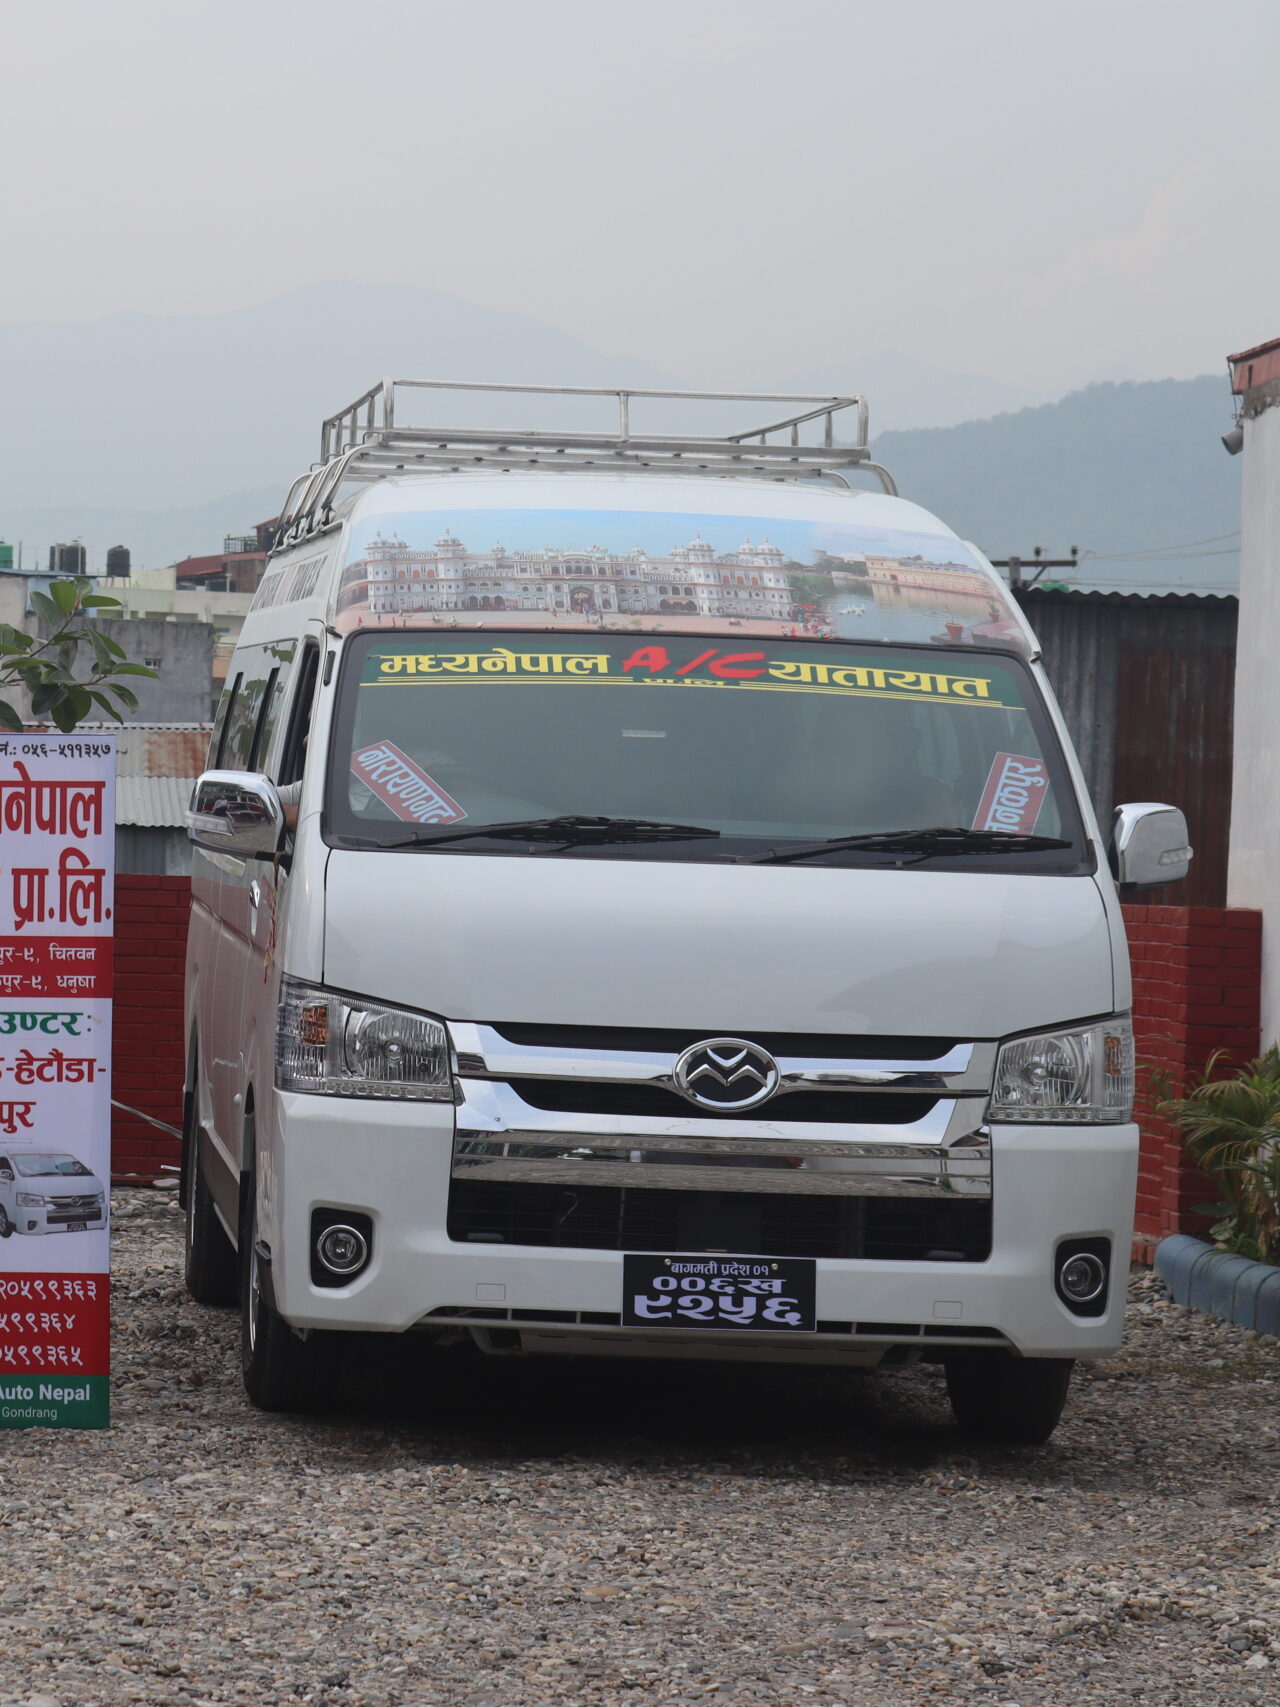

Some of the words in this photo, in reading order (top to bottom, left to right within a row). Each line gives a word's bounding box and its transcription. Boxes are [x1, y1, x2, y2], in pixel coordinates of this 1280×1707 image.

[380, 647, 610, 676] मध्यनेपाल
[622, 645, 768, 679] A/C
[768, 660, 991, 698] यातायात
[22, 743, 111, 758] ०५६-५११३५७
[11, 847, 113, 932] प्रा.लि.
[49, 943, 97, 961] चितवन
[56, 975, 97, 994] धनुषा
[671, 1261, 718, 1275] बागमती
[721, 1262, 750, 1277] प्रदेश
[753, 1265, 769, 1276] ०१
[39, 1384, 91, 1405] Nepal
[1, 1407, 58, 1421] Gondrang
